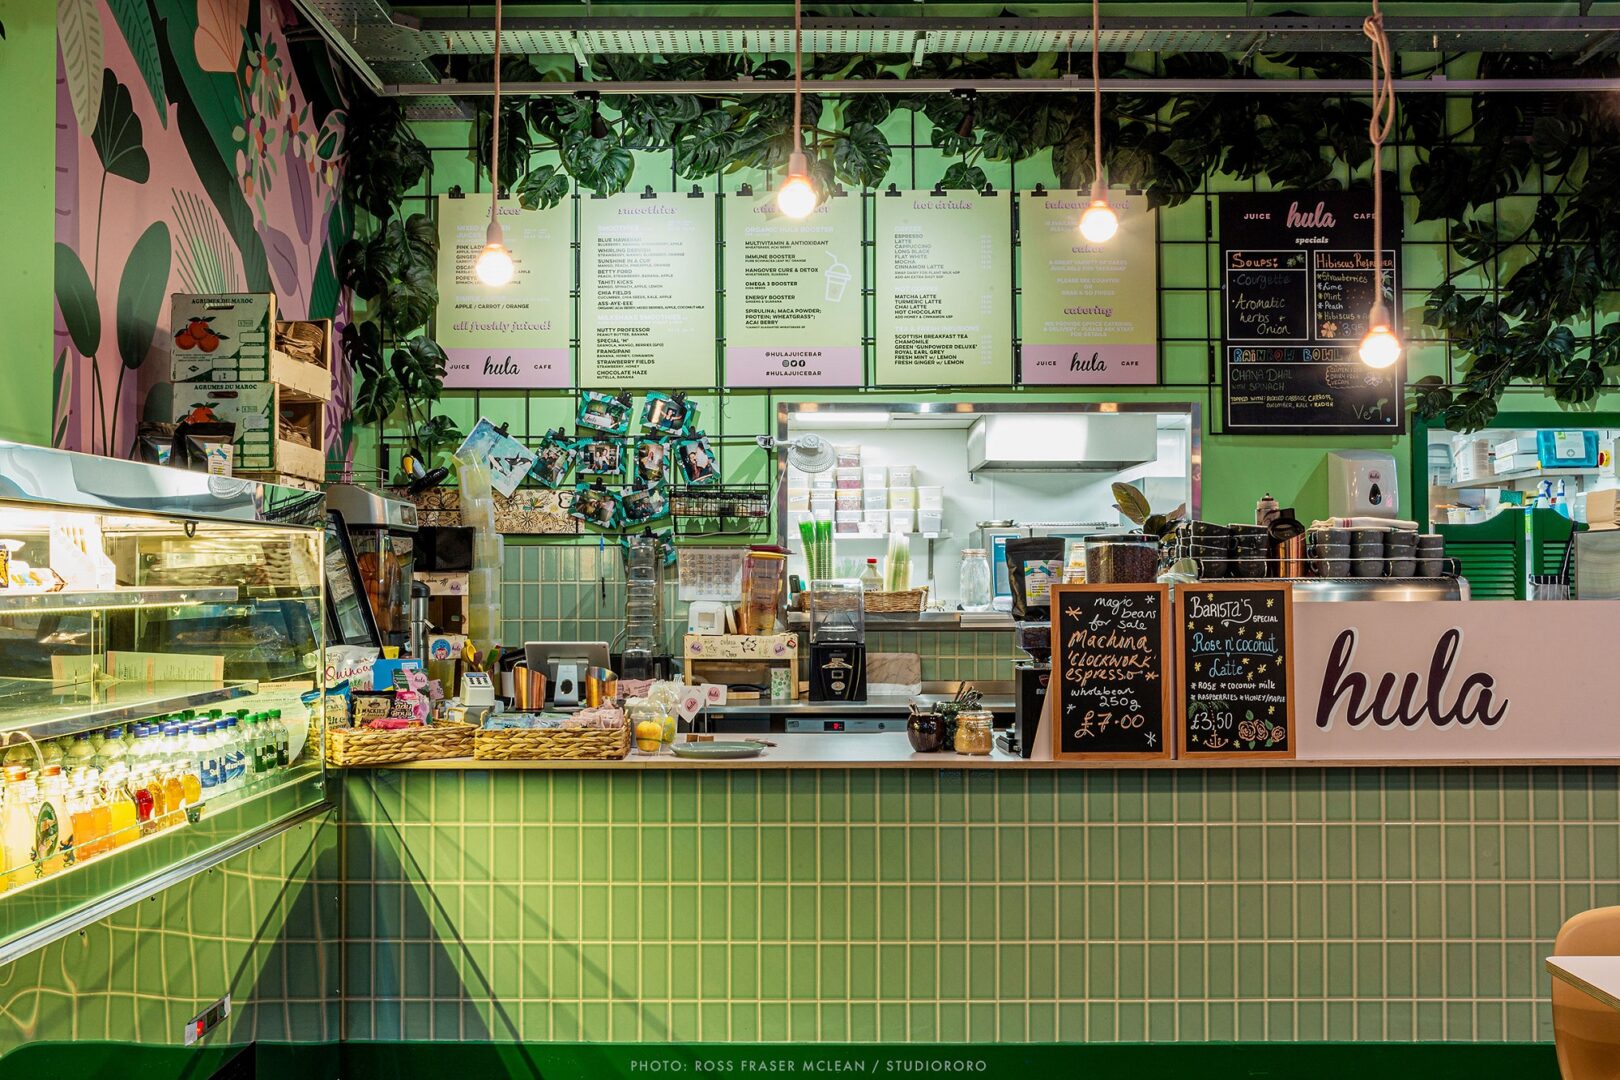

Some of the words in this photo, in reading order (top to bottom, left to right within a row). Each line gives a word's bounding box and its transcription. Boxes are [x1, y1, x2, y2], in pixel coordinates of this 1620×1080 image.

[913, 200, 933, 210] hot
[935, 200, 973, 210] drinks
[1286, 201, 1336, 228] hula
[1295, 236, 1329, 245] specials
[1316, 253, 1355, 269] Hibiscus
[1235, 293, 1286, 310] Aromatic
[1324, 292, 1342, 301] Mint
[1063, 305, 1113, 317] catering
[1324, 301, 1344, 311] Peach
[1239, 313, 1270, 323] herbs
[1257, 323, 1291, 335] Onion
[483, 355, 520, 375] hula
[1070, 352, 1107, 372] hula
[1093, 596, 1134, 615] magic
[1121, 608, 1157, 619] beans
[1088, 613, 1112, 631] for
[1117, 619, 1147, 630] sale
[1252, 614, 1278, 623] SPECIAL
[1067, 629, 1152, 653] Machina
[1191, 632, 1222, 653] Rose
[1235, 633, 1279, 653] coconut
[325, 665, 369, 681] Quinoa
[1208, 657, 1244, 678] Latte
[1065, 667, 1144, 687] espresso
[1315, 627, 1510, 733] hula
[1197, 681, 1217, 691] ROSE
[1227, 682, 1257, 690] coconut
[1258, 680, 1276, 689] milk
[1099, 696, 1142, 711] 250g
[1197, 693, 1238, 702] RASPBERRIES
